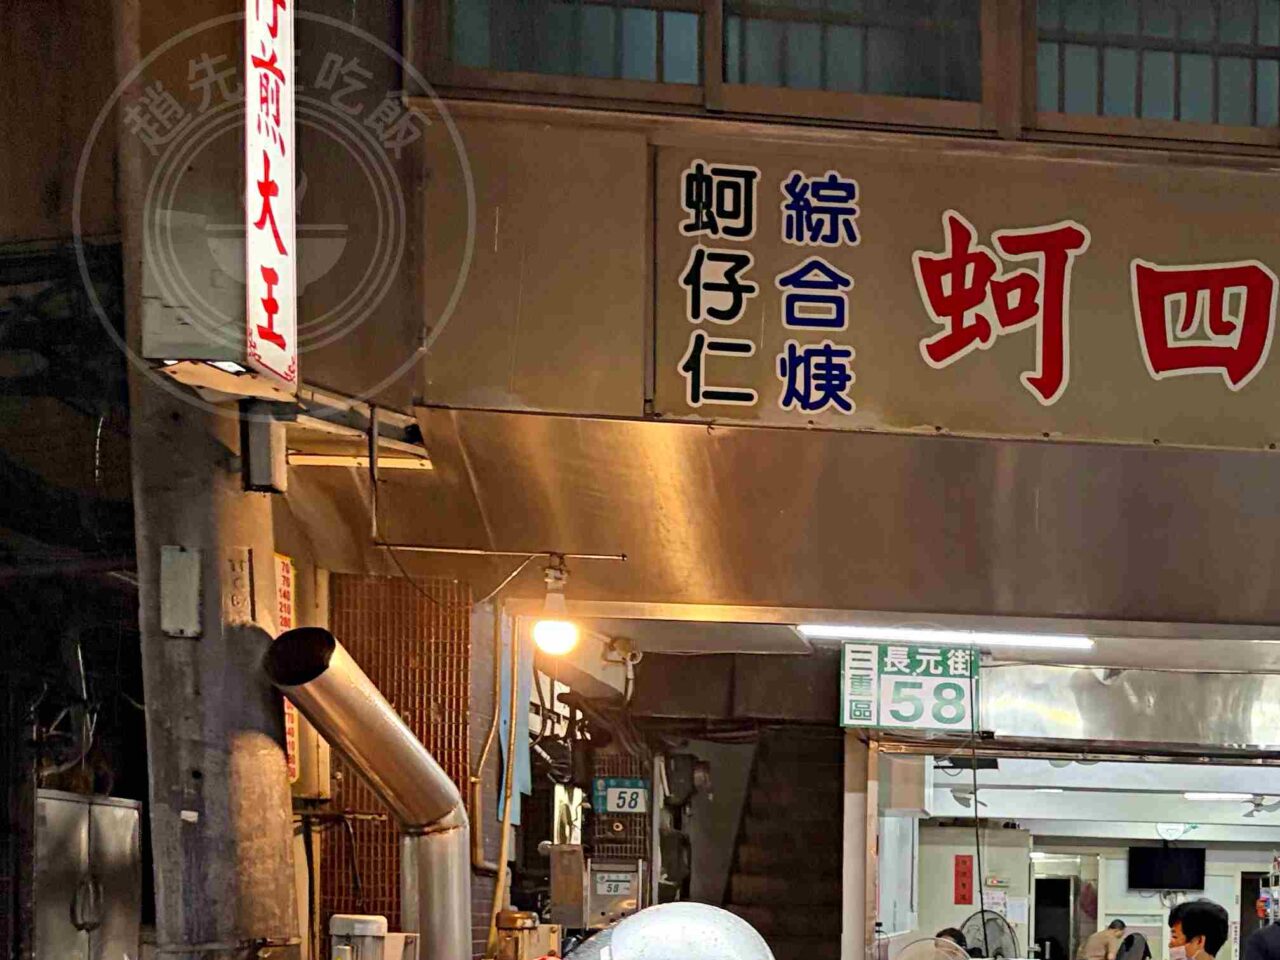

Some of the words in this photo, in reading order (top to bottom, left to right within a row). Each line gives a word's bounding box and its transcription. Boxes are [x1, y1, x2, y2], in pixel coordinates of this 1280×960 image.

[682, 160, 757, 406] 蚵仔仁
[883, 647, 975, 675] 長元街
[849, 649, 875, 721] 三重區
[889, 681, 967, 724] 58
[616, 791, 639, 809] 58
[606, 883, 620, 893] 58
